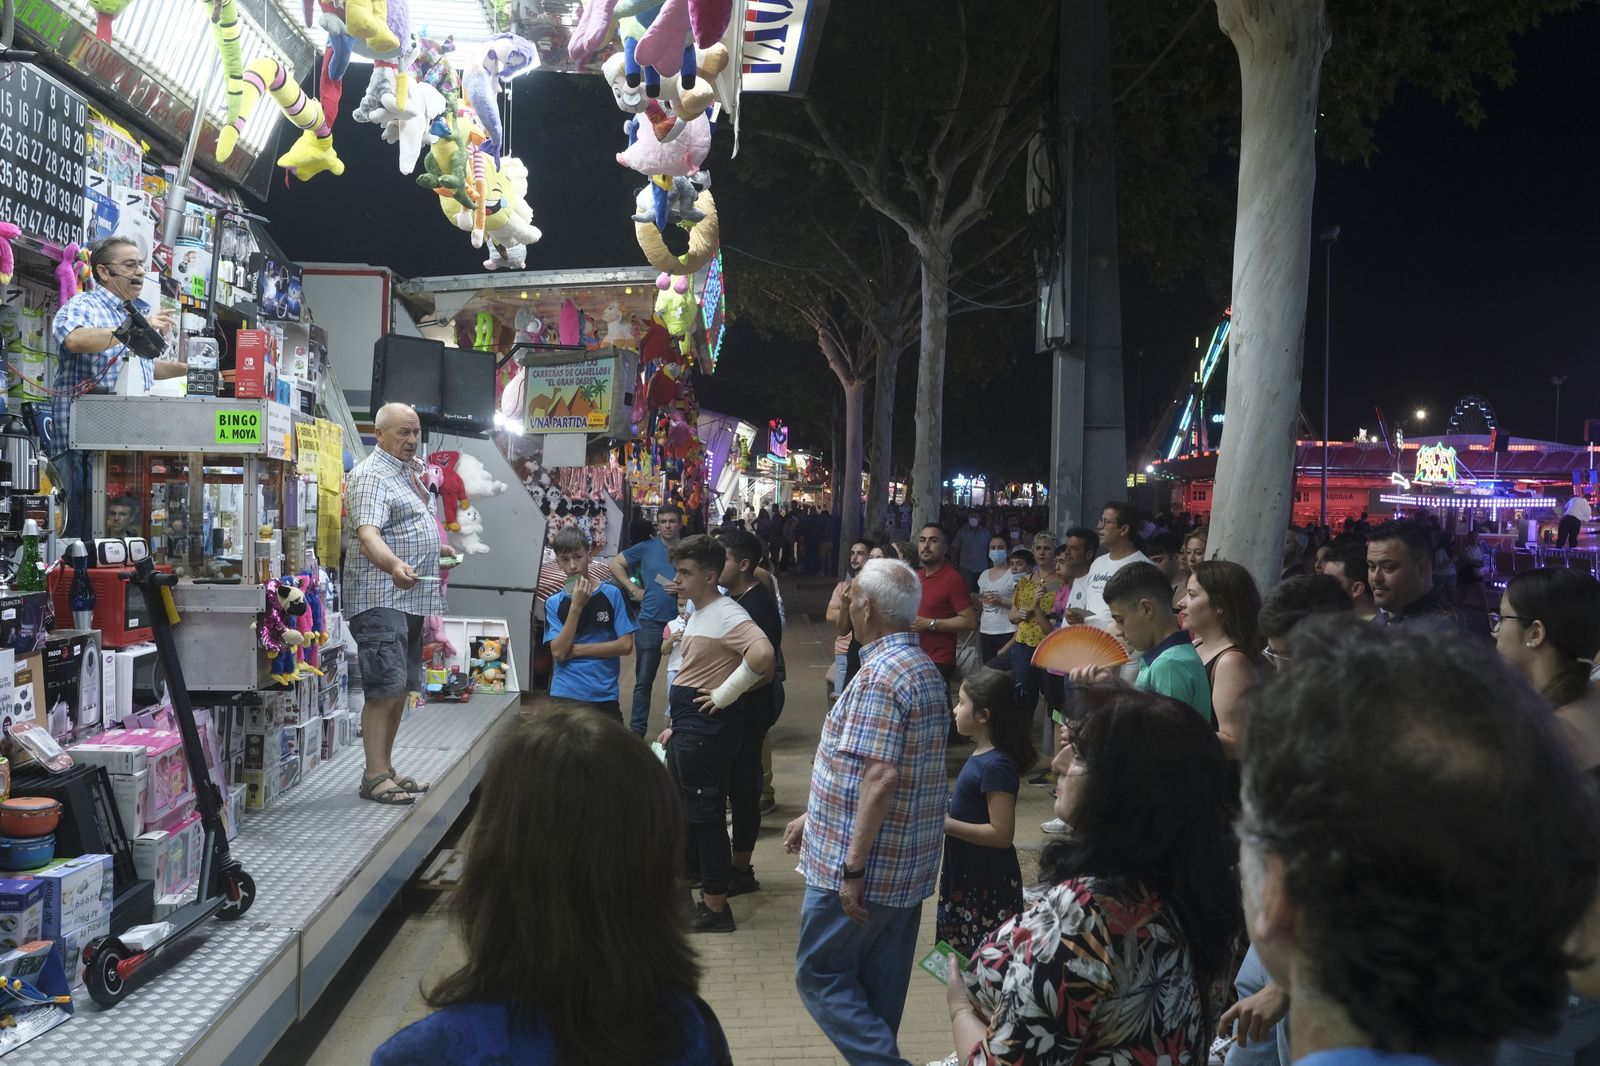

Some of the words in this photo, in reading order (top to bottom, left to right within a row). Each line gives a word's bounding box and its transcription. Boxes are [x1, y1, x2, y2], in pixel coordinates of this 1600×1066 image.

[21, 67, 27, 91] 6
[36, 76, 41, 99] 7
[50, 86, 56, 109] 8
[64, 94, 69, 117] 9
[76, 102, 85, 127] 10
[1, 89, 12, 117] 15
[19, 99, 29, 126] 16
[34, 108, 43, 133] 17
[48, 117, 57, 141] 18
[62, 124, 70, 149] 19
[74, 131, 84, 156] 20
[1, 123, 12, 151] 25
[16, 132, 28, 160] 26
[31, 139, 43, 165] 27
[46, 148, 57, 175] 28
[60, 157, 71, 183] 29
[73, 162, 83, 188] 30
[0, 159, 12, 187] 35
[15, 167, 28, 194] 36
[31, 174, 42, 200] 37
[45, 181, 56, 206] 38
[59, 189, 70, 214] 39
[72, 194, 82, 218] 40
[0, 196, 11, 222] 45
[14, 202, 27, 229] 46
[29, 210, 42, 234] 47
[43, 215, 55, 239] 48
[57, 222, 69, 245] 49
[72, 225, 82, 248] 50
[533, 369, 564, 378] CARRERAS
[565, 368, 574, 377] DE
[557, 378, 575, 387] GRAN
[219, 414, 257, 426] BINGO
[219, 429, 229, 439] A.
[232, 429, 257, 439] MOYA
[530, 416, 549, 429] UNA
[550, 416, 588, 429] PARTIDA
[45, 880, 53, 910] Pillow
